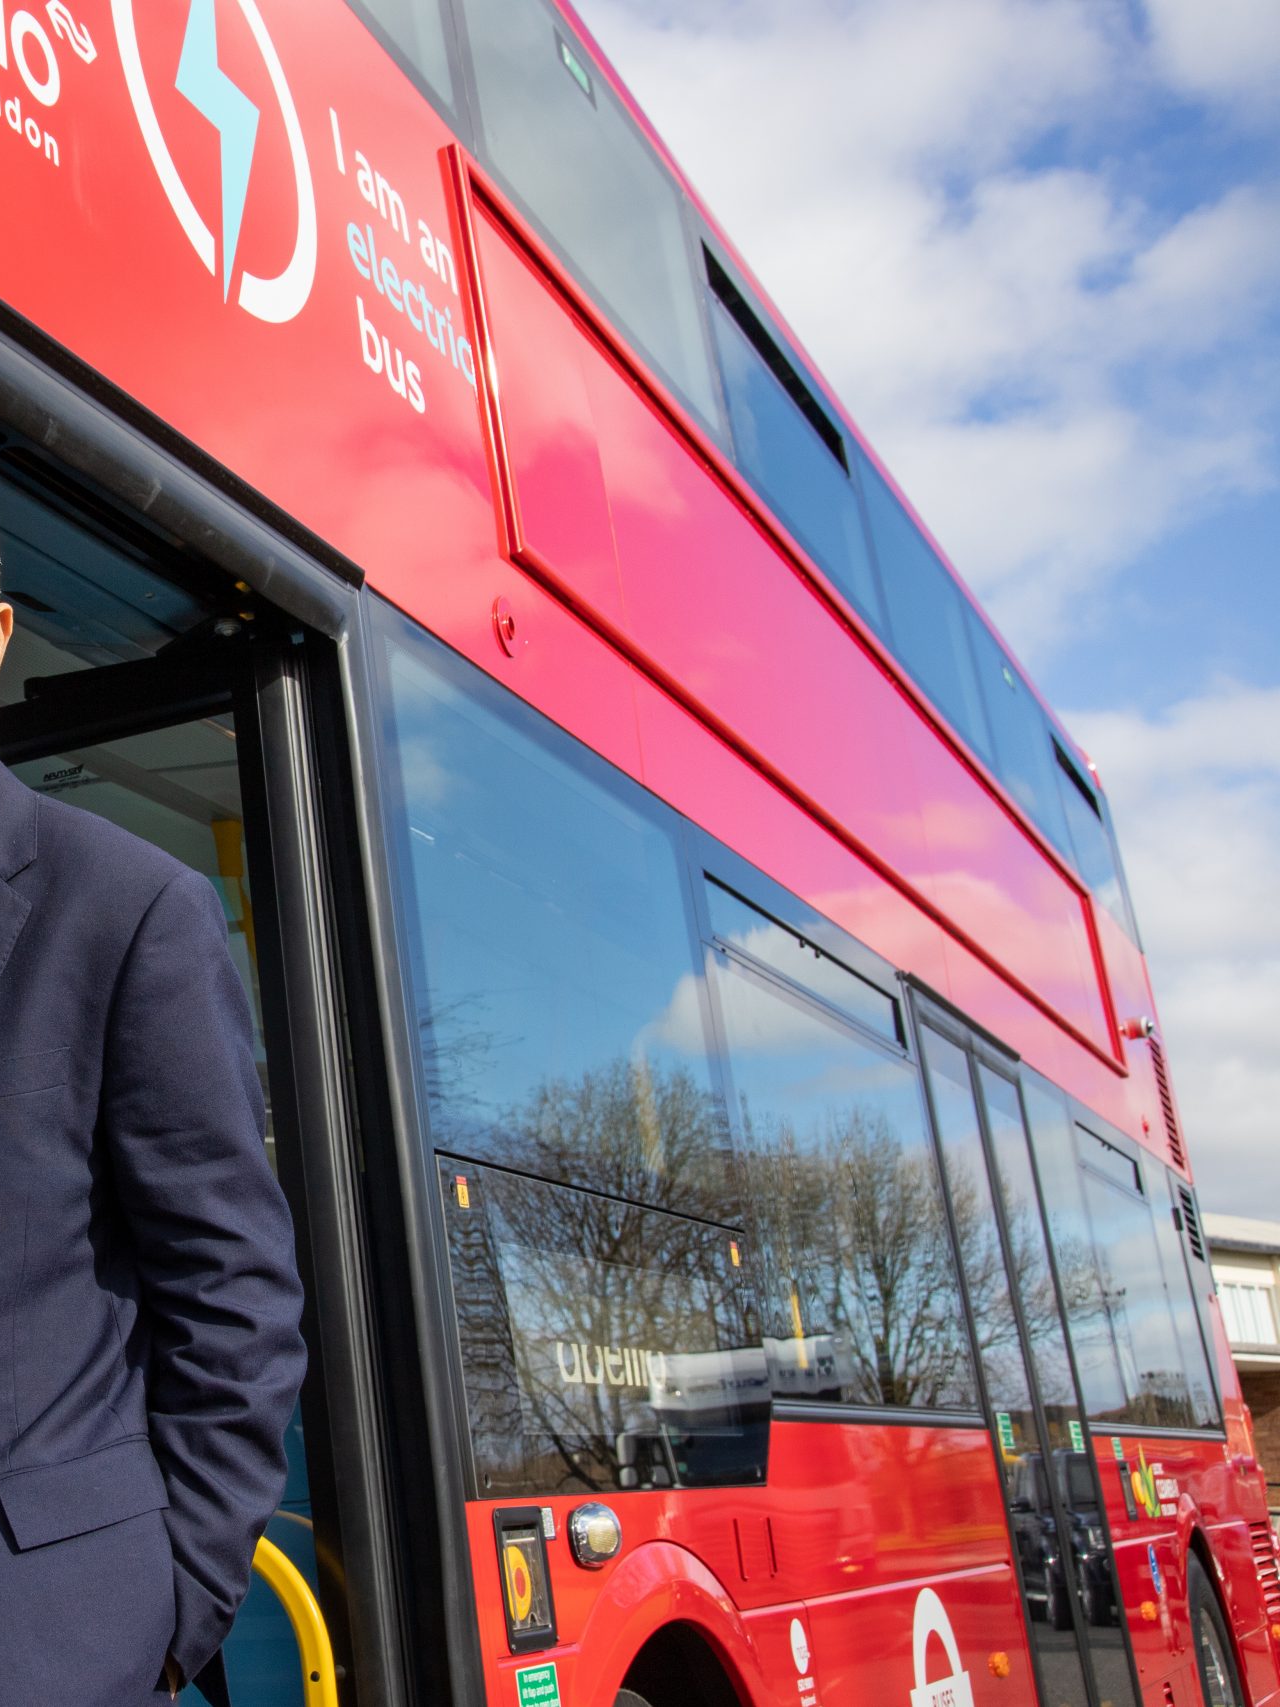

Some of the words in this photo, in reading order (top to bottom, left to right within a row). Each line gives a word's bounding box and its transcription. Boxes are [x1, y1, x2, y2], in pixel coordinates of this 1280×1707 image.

[329, 106, 346, 176] I
[355, 150, 411, 244] am
[418, 218, 459, 296] an
[346, 222, 477, 387] electric
[356, 295, 426, 414] bus
